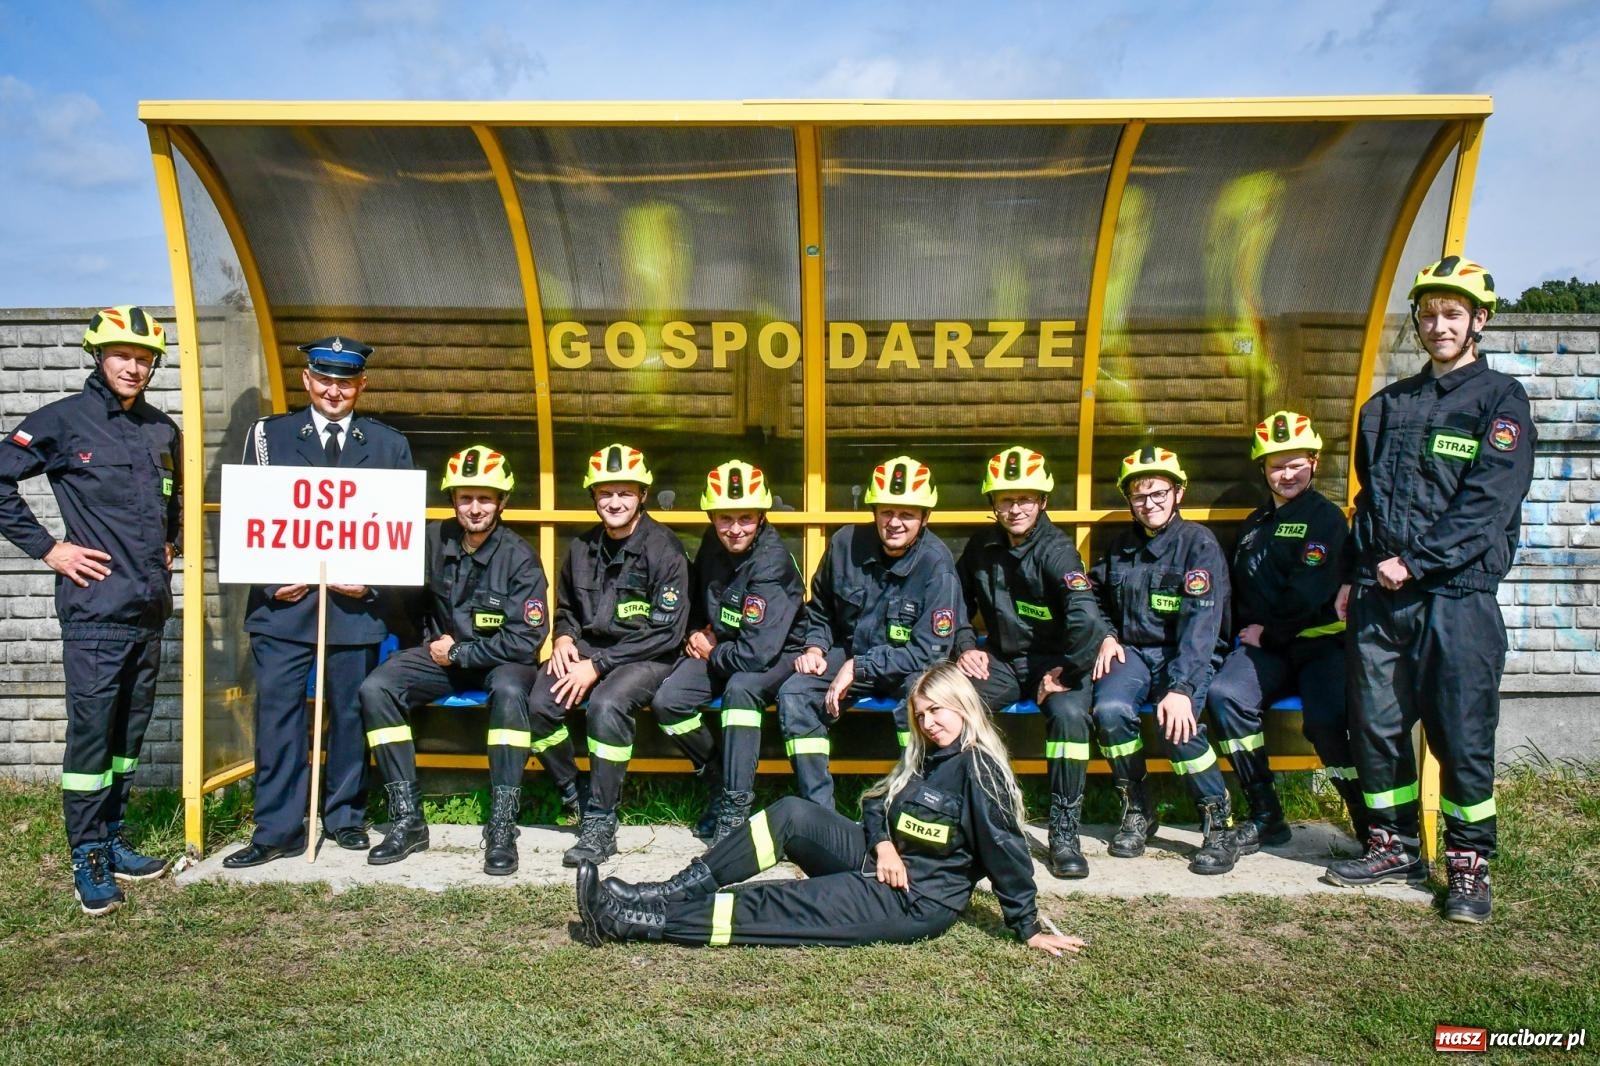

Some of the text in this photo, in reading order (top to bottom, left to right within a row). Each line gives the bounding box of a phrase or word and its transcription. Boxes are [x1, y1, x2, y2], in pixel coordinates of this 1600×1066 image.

[548, 321, 1077, 369] GOSPODARZE
[293, 479, 357, 510] OSP
[246, 512, 413, 551] RZUCHÓW
